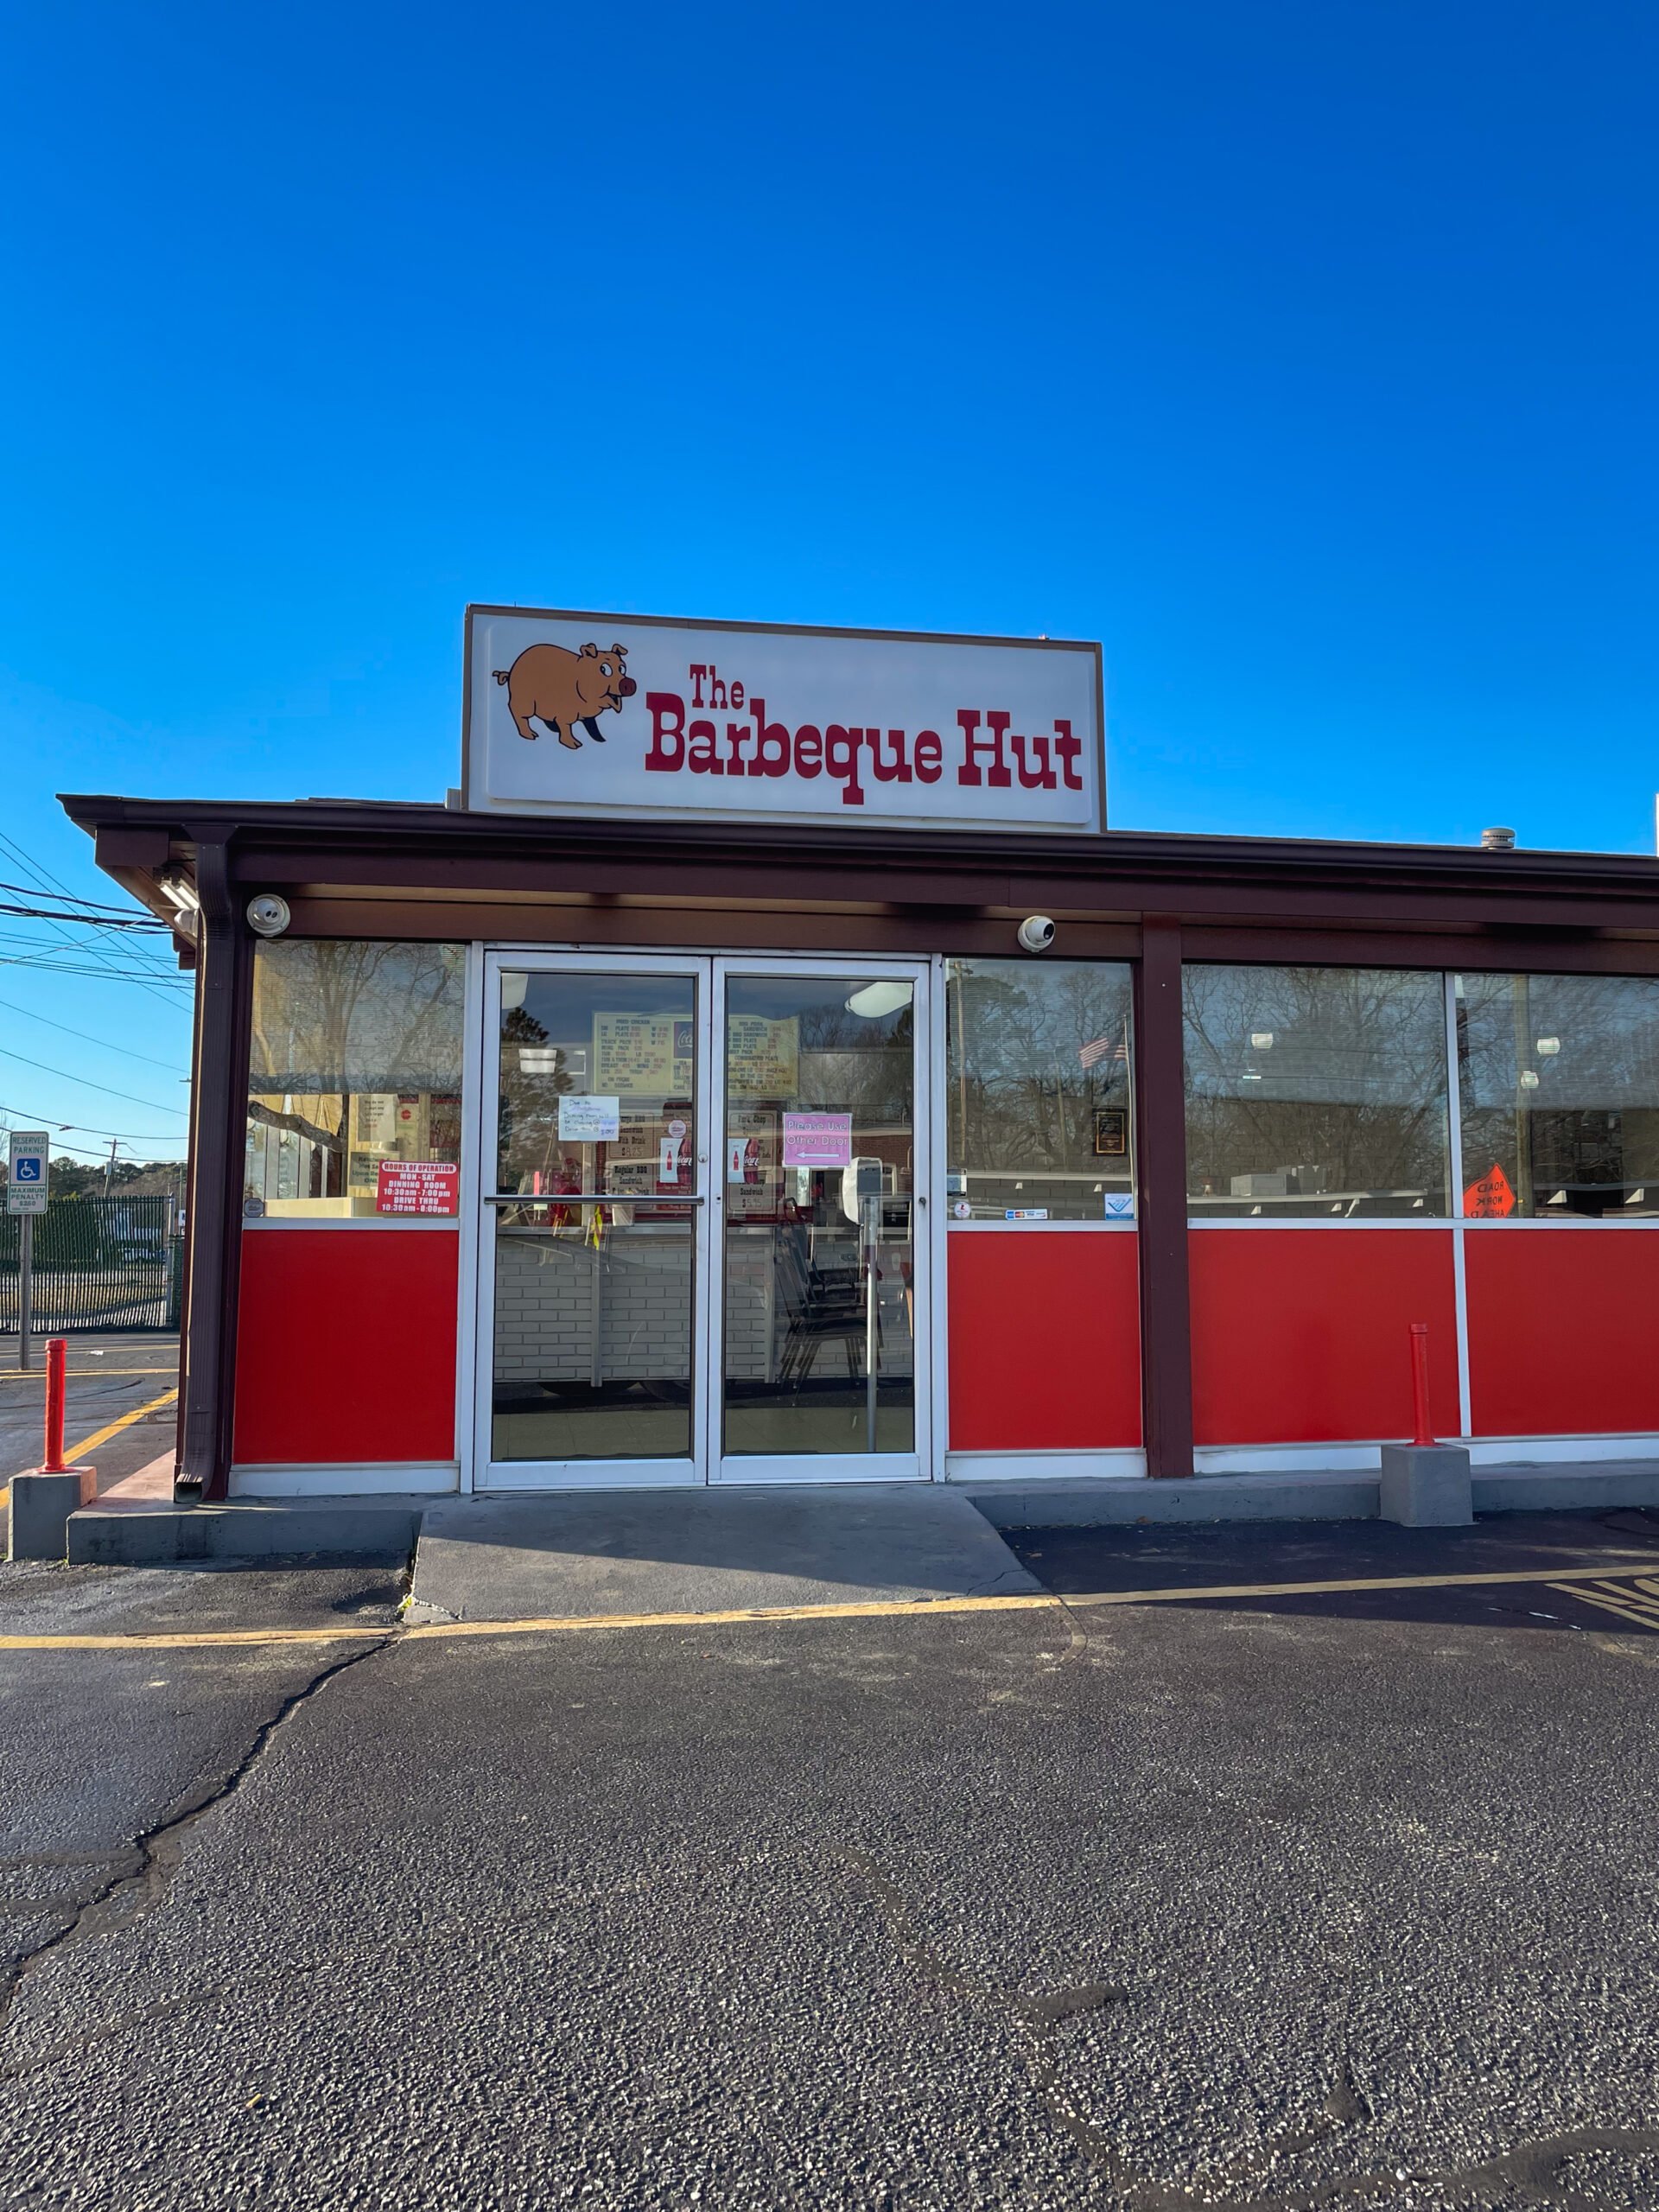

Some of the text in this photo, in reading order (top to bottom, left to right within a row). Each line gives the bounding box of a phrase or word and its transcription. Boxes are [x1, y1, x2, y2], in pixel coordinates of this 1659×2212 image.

[690, 664, 745, 709] The
[645, 692, 1083, 805] Barbeque Hut
[787, 1121, 847, 1131] Please Use
[12, 1136, 46, 1145] RESERVED
[787, 1135, 848, 1146] Other Door
[14, 1146, 45, 1154] PARKING
[385, 1163, 407, 1172] HOURS
[389, 1180, 420, 1189] DINNING
